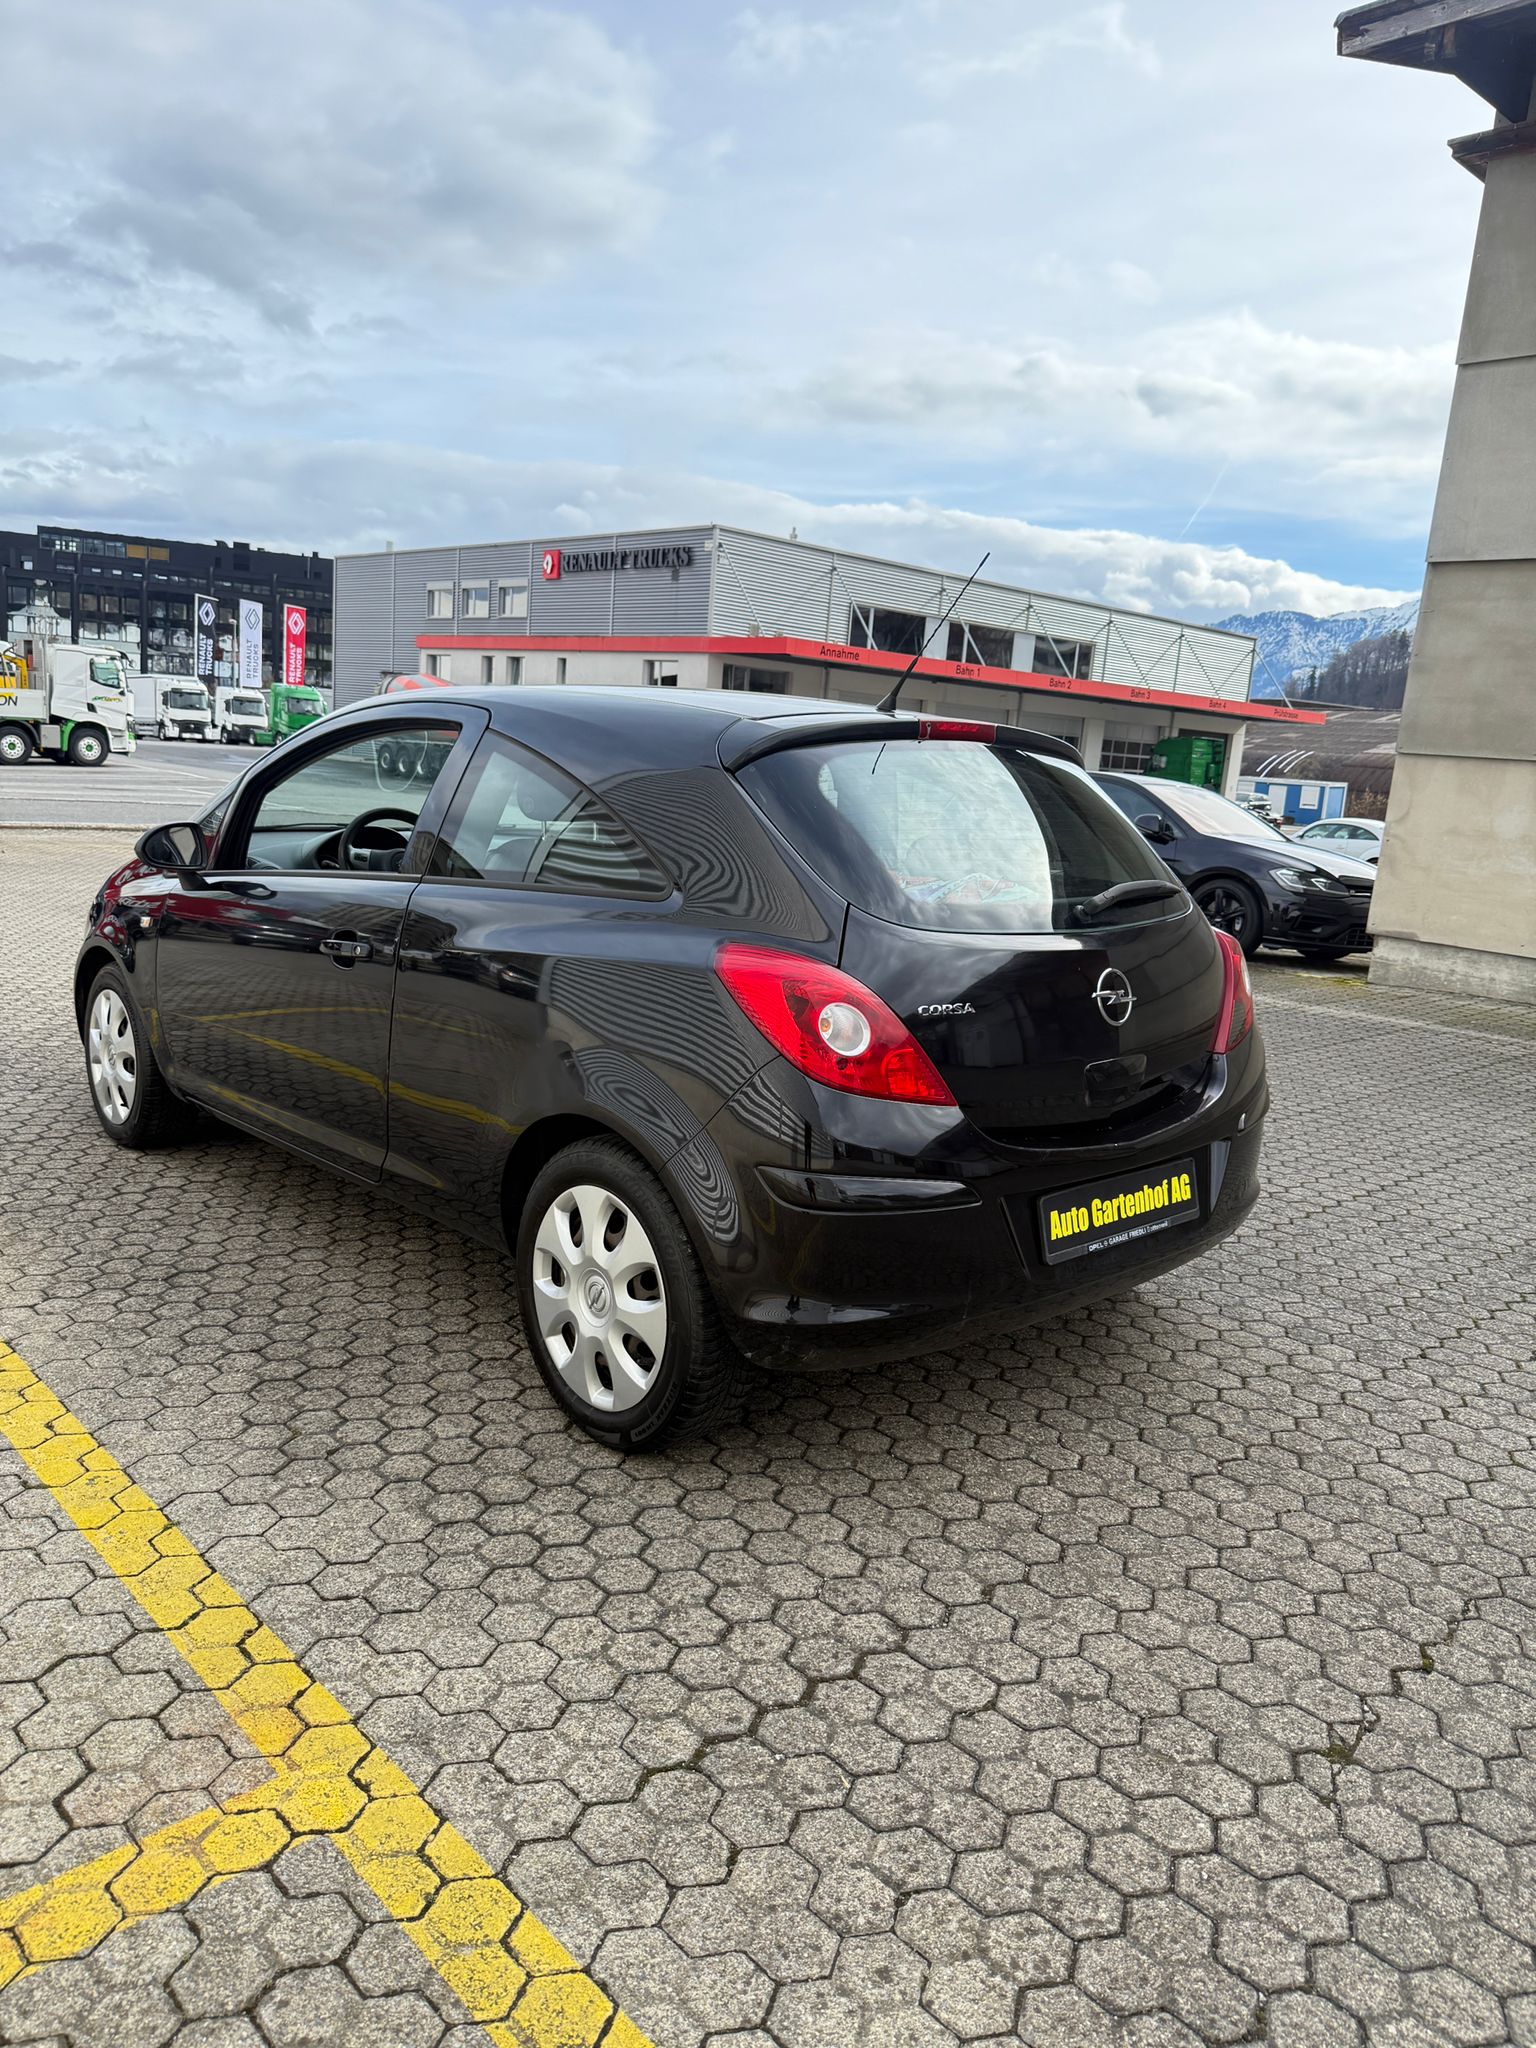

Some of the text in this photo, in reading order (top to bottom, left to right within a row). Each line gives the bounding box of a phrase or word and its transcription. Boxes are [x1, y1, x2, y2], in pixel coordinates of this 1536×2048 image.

[560, 547, 690, 572] RENAULT TRUCKS
[819, 645, 860, 661] Annahme
[955, 664, 974, 677] Bahn
[1049, 677, 1066, 689] Bahn
[1130, 689, 1145, 699] Bahn
[918, 1002, 976, 1016] CORSA
[1050, 1173, 1191, 1240] Auto Gartenhof AG
[1088, 1242, 1105, 1252] OPEL
[1109, 1234, 1128, 1245] GARAGE
